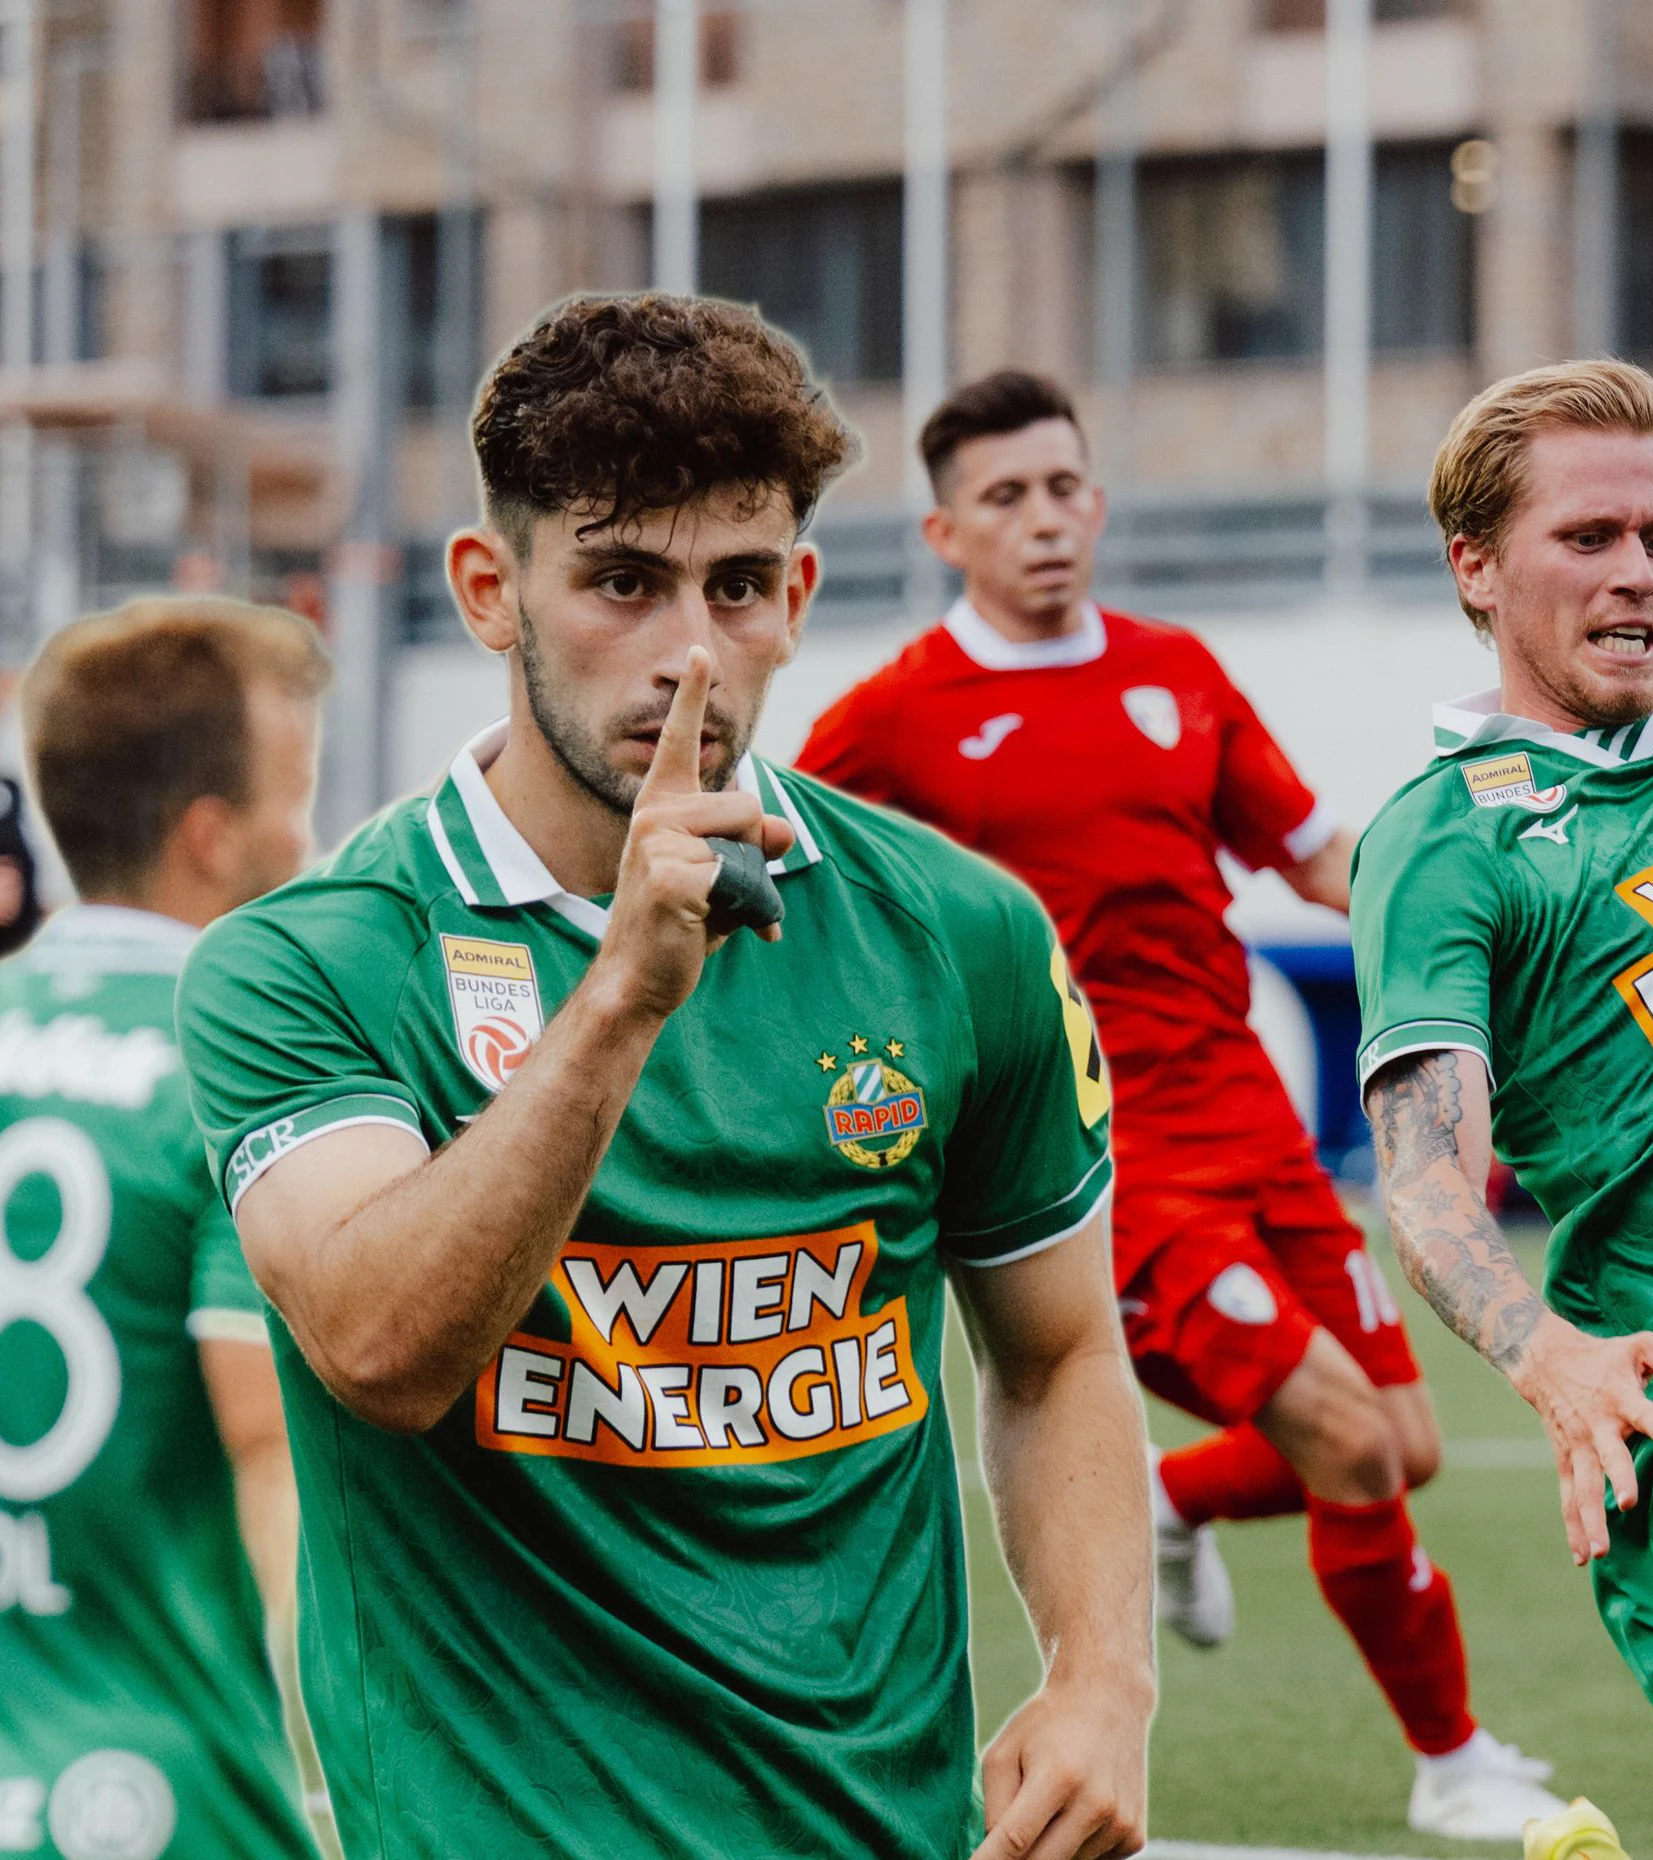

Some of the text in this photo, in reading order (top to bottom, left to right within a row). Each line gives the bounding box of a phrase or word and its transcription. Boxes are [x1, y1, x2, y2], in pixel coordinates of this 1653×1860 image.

[1471, 763, 1527, 784] ADMIRAL
[1477, 784, 1532, 804] BUNDES
[452, 949, 527, 970] ADMIRAL
[455, 977, 532, 998] BUNDES
[474, 995, 517, 1013] LIGA
[832, 1097, 920, 1135] RAPID
[231, 1118, 301, 1188] SCR
[560, 1240, 865, 1347] WIEN
[494, 1318, 913, 1453] ENERGIE
